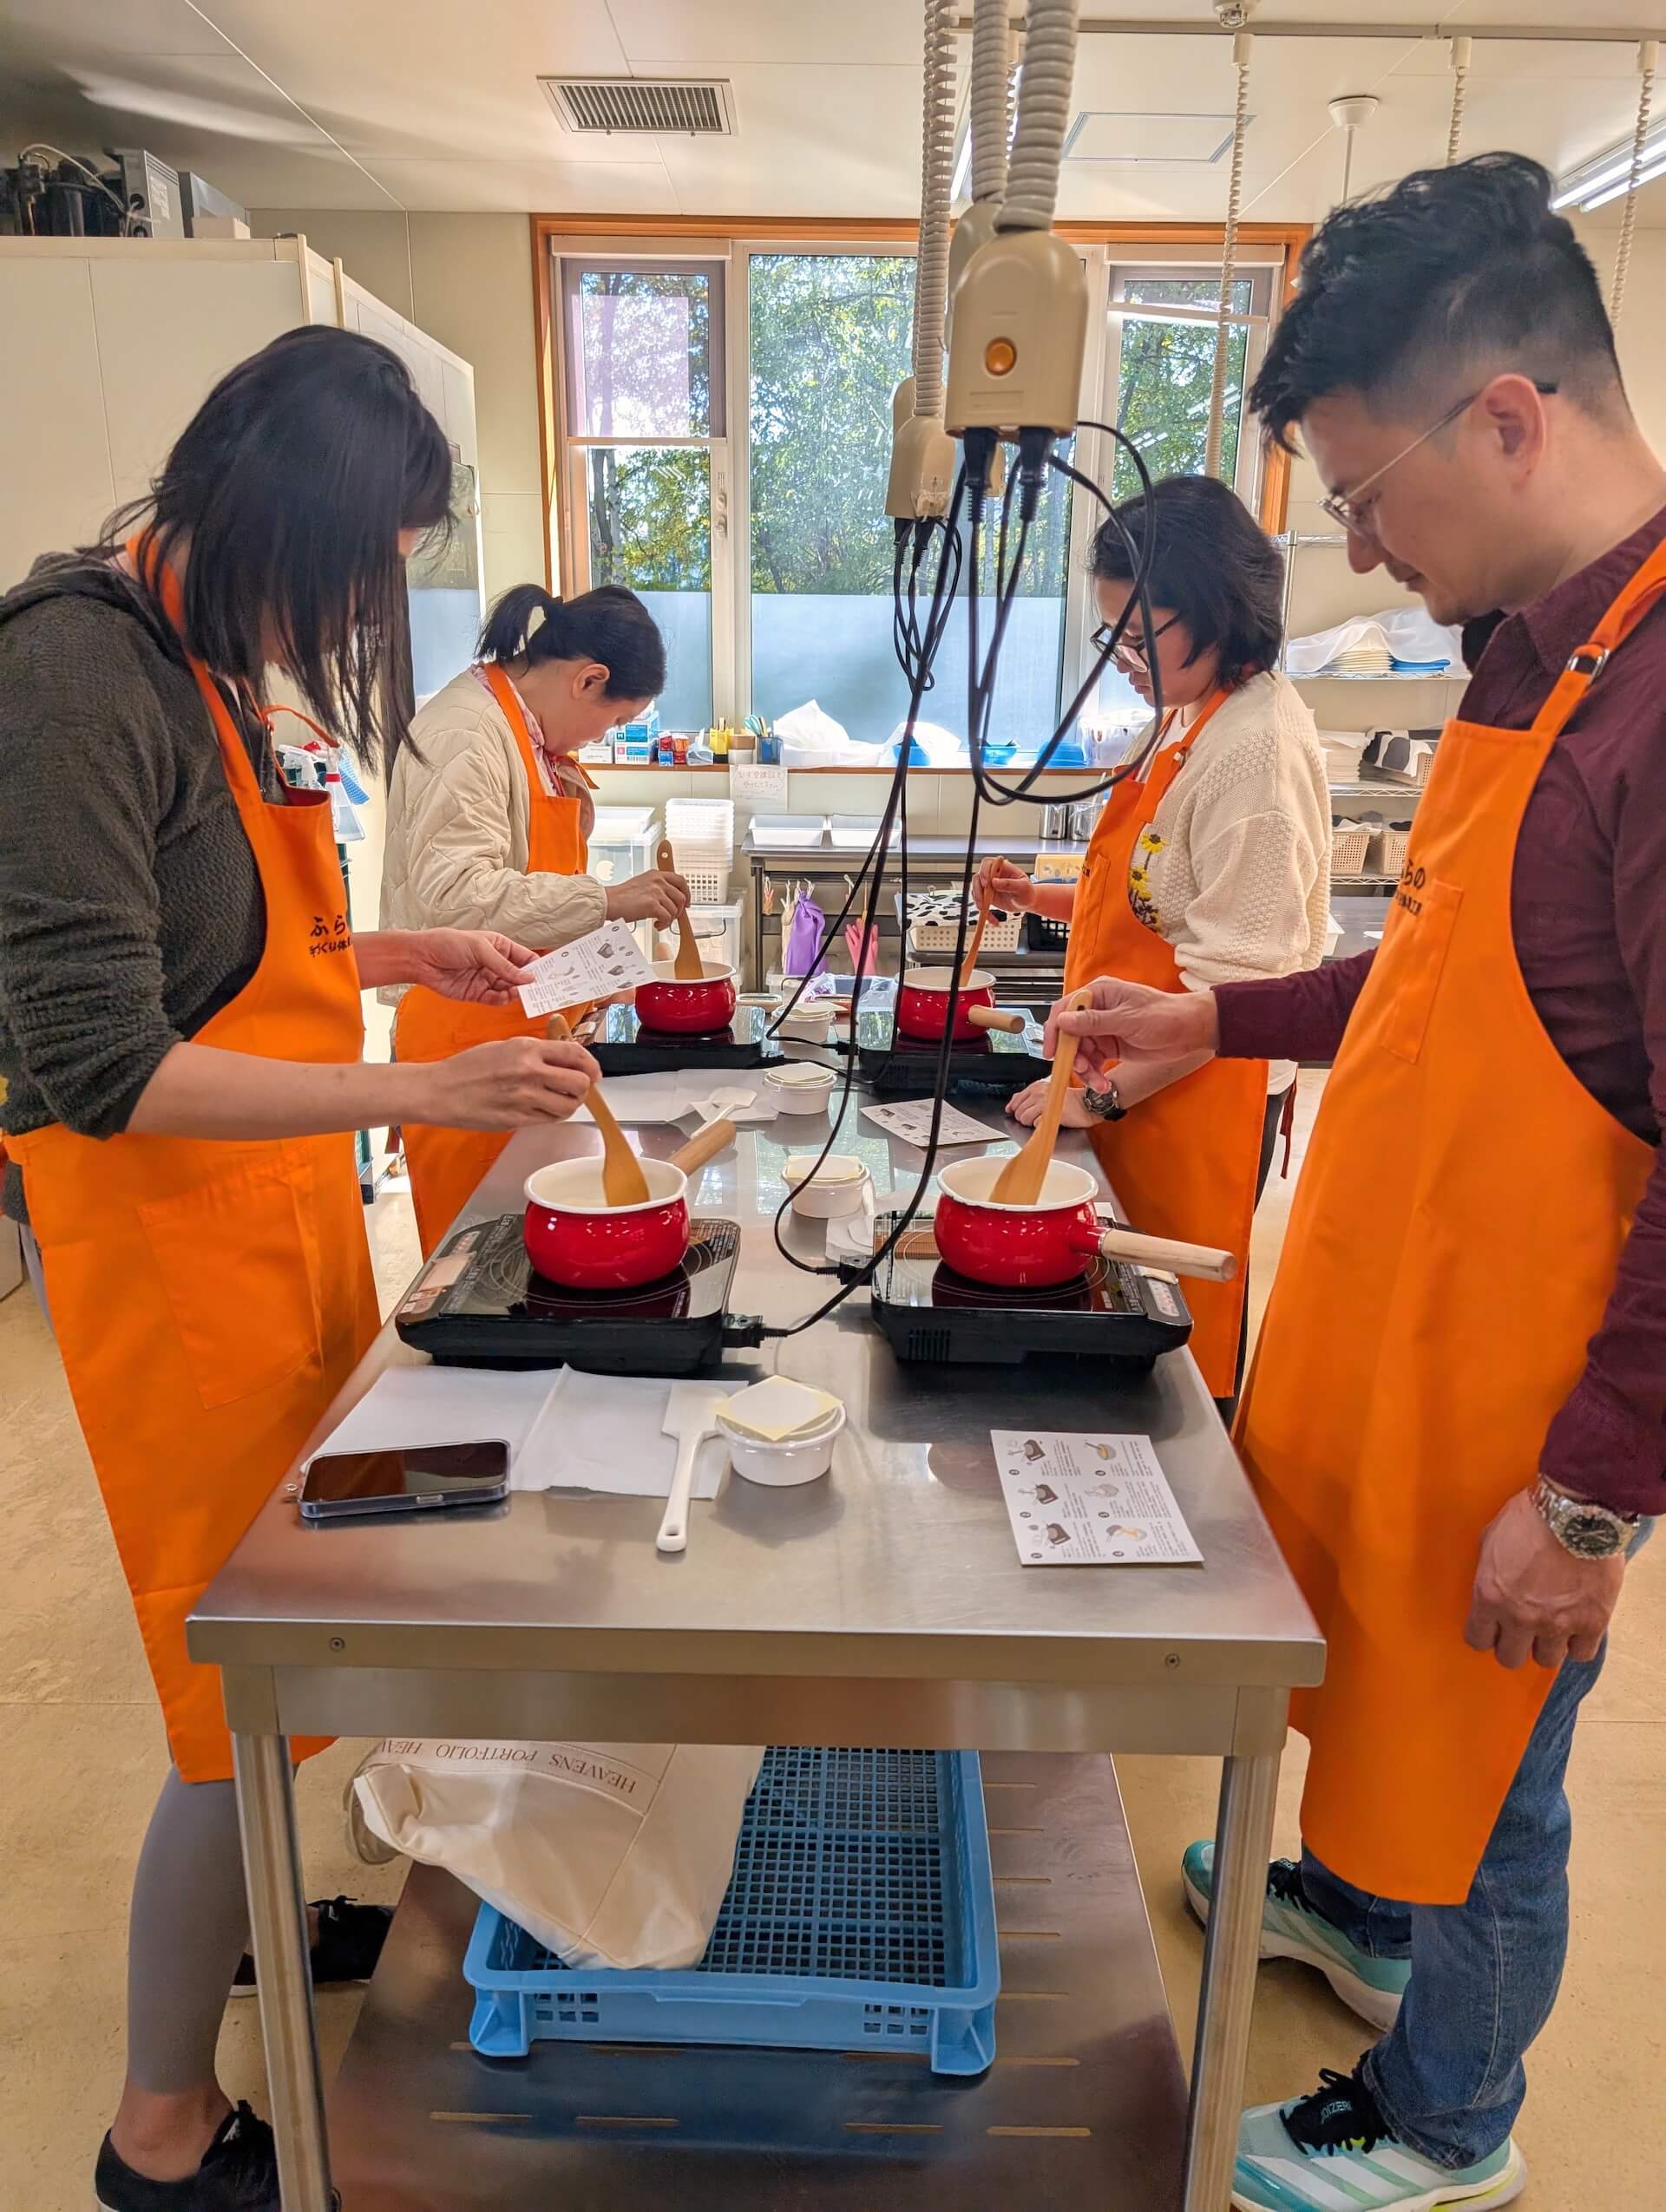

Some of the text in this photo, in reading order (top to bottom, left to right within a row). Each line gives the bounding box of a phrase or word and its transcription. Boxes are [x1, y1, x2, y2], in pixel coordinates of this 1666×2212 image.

[1400, 858, 1427, 891] らの
[436, 1744, 538, 1762] PORTFOLIO
[548, 1753, 637, 1794] HEAVENS
